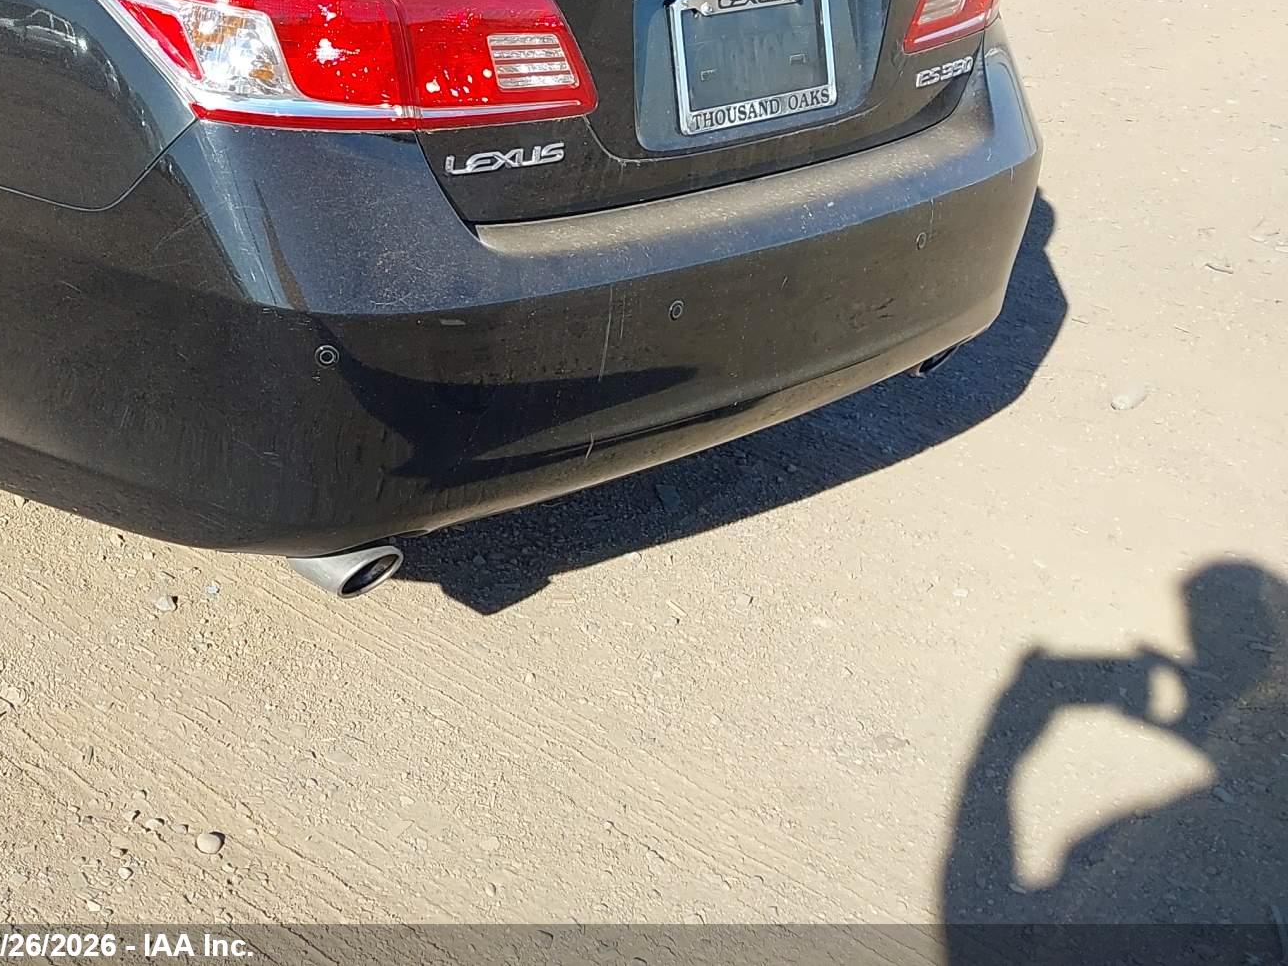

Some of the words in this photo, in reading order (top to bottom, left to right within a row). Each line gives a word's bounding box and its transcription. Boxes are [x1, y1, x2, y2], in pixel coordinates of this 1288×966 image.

[691, 97, 781, 131] THOUSAND
[787, 87, 831, 111] OAKS
[445, 141, 565, 175] LEXUS
